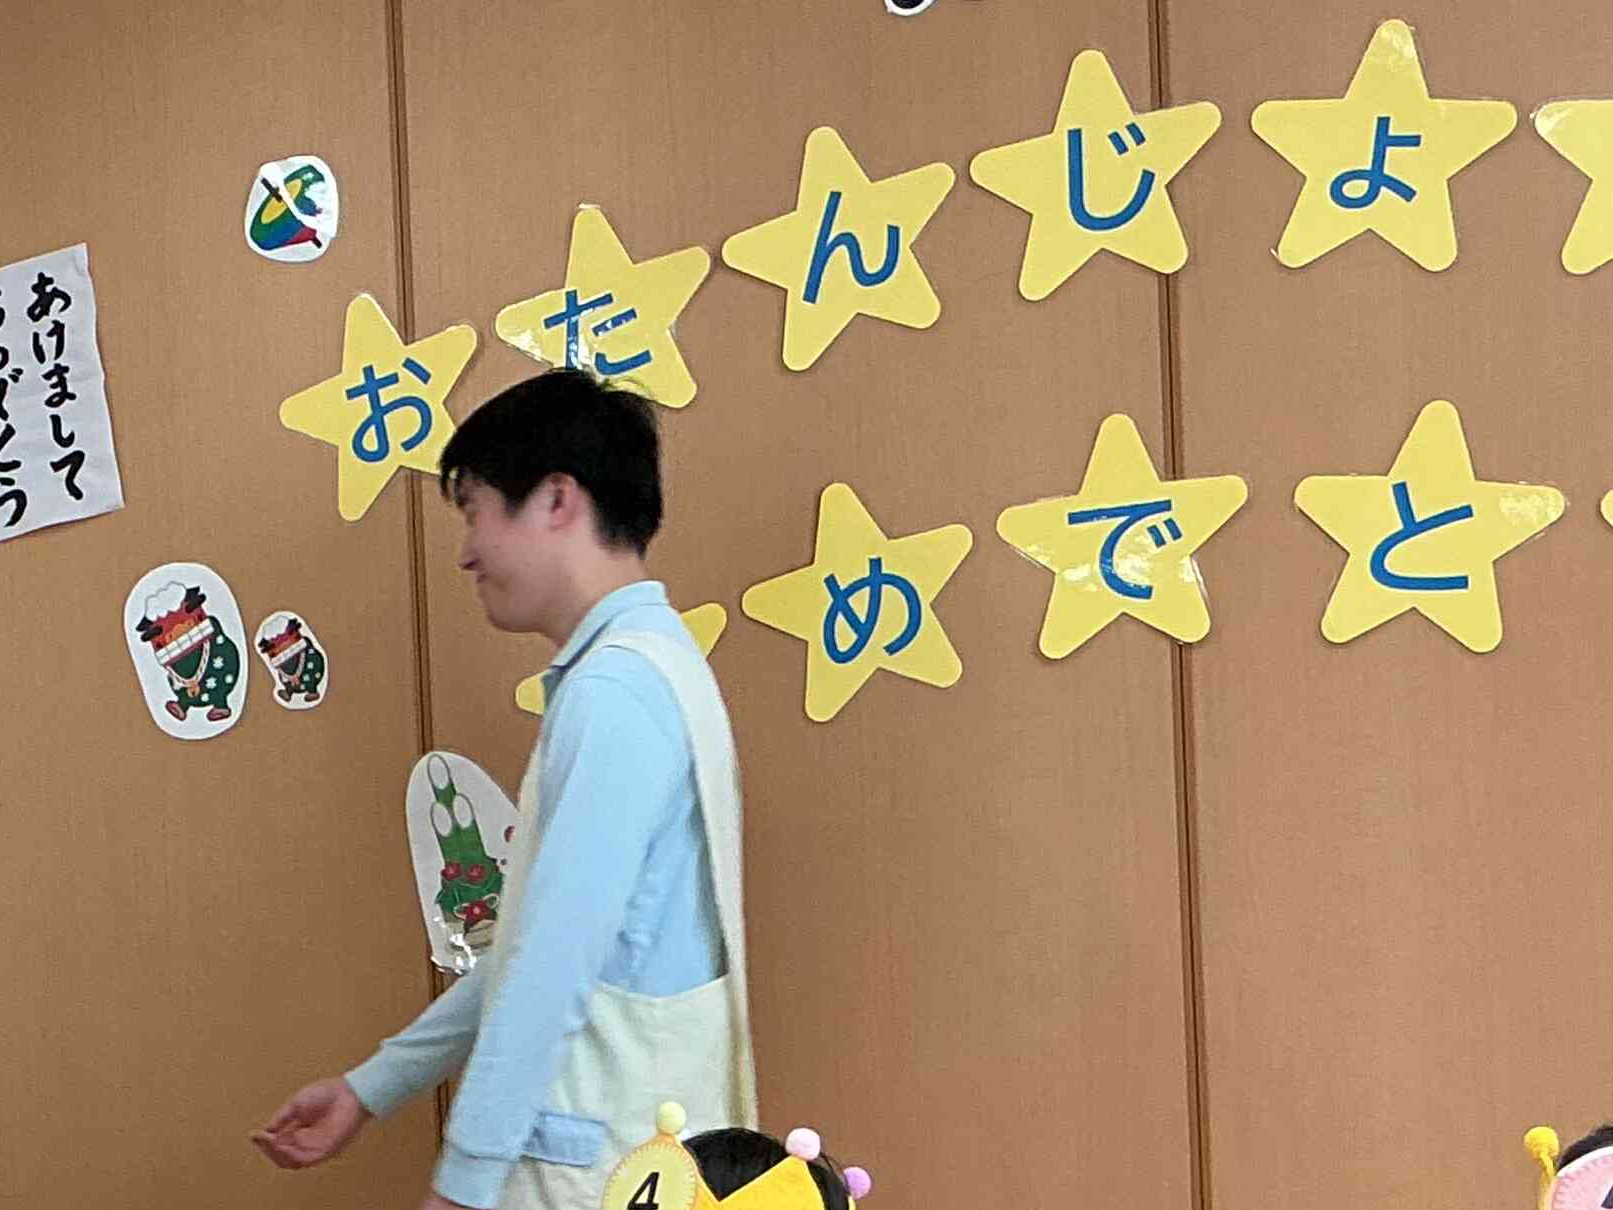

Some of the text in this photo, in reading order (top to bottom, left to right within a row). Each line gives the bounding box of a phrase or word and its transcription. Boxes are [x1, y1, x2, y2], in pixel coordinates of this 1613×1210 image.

[26, 271, 86, 501] あけまして
